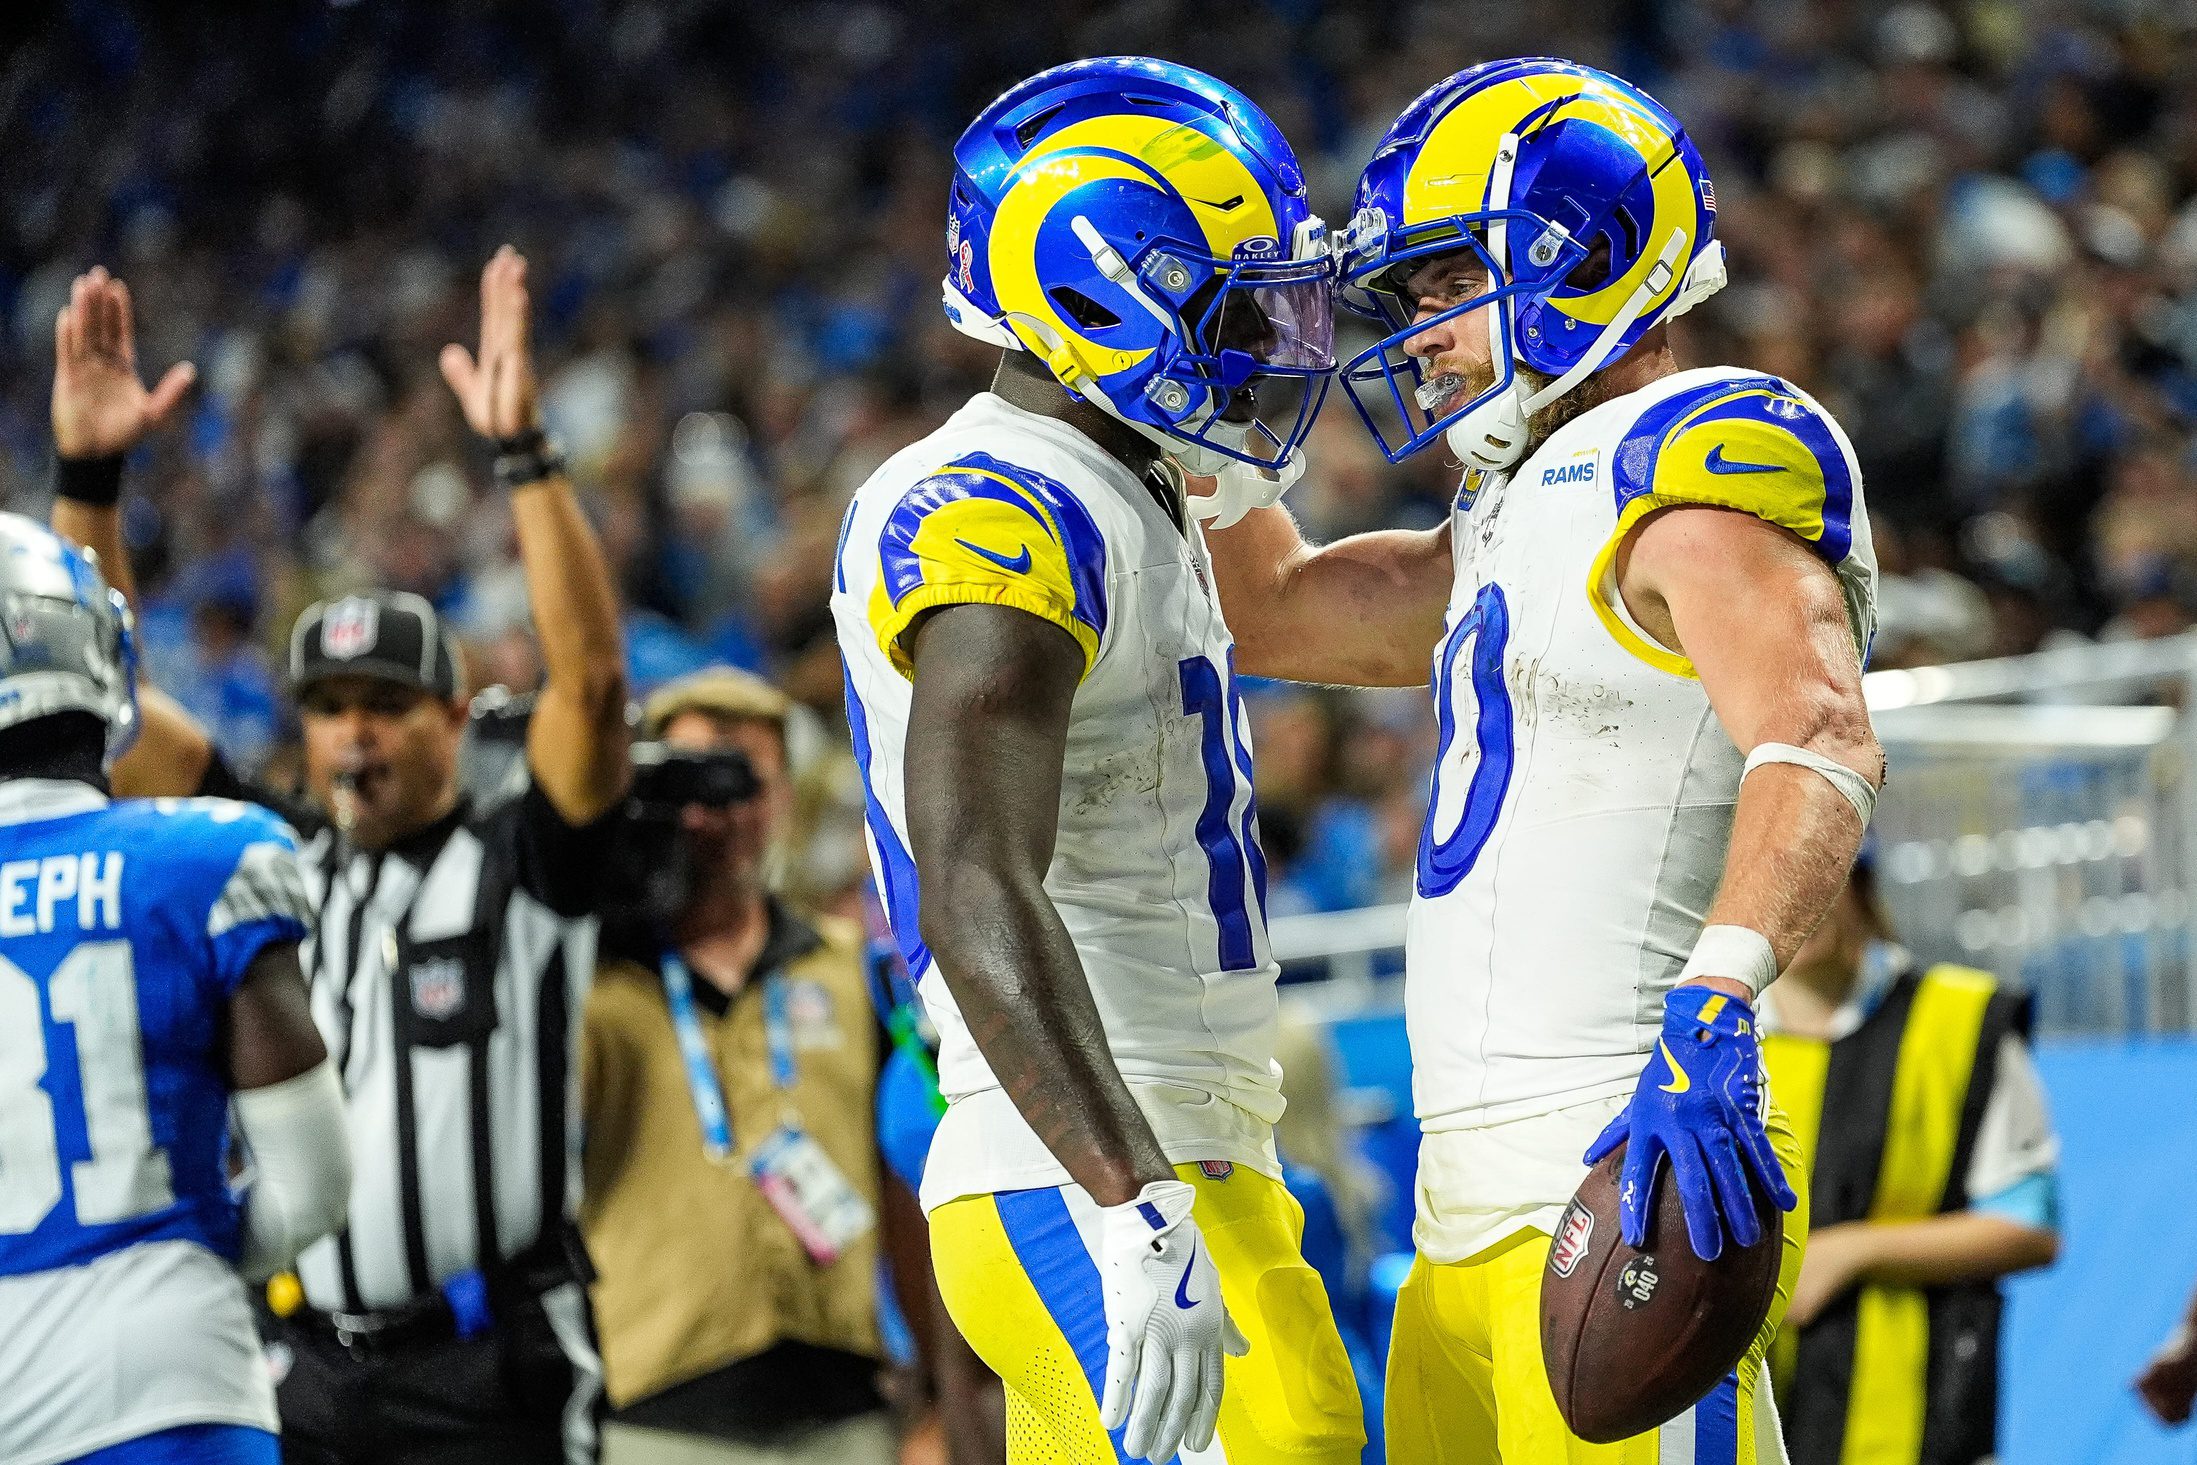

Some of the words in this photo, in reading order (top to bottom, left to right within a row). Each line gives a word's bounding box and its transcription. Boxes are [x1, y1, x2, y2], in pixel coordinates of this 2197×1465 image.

[1234, 251, 1279, 260] OAKLEY
[1541, 462, 1595, 486] RAMS
[1554, 1215, 1590, 1270] NFL
[1632, 1270, 1659, 1302] 040
